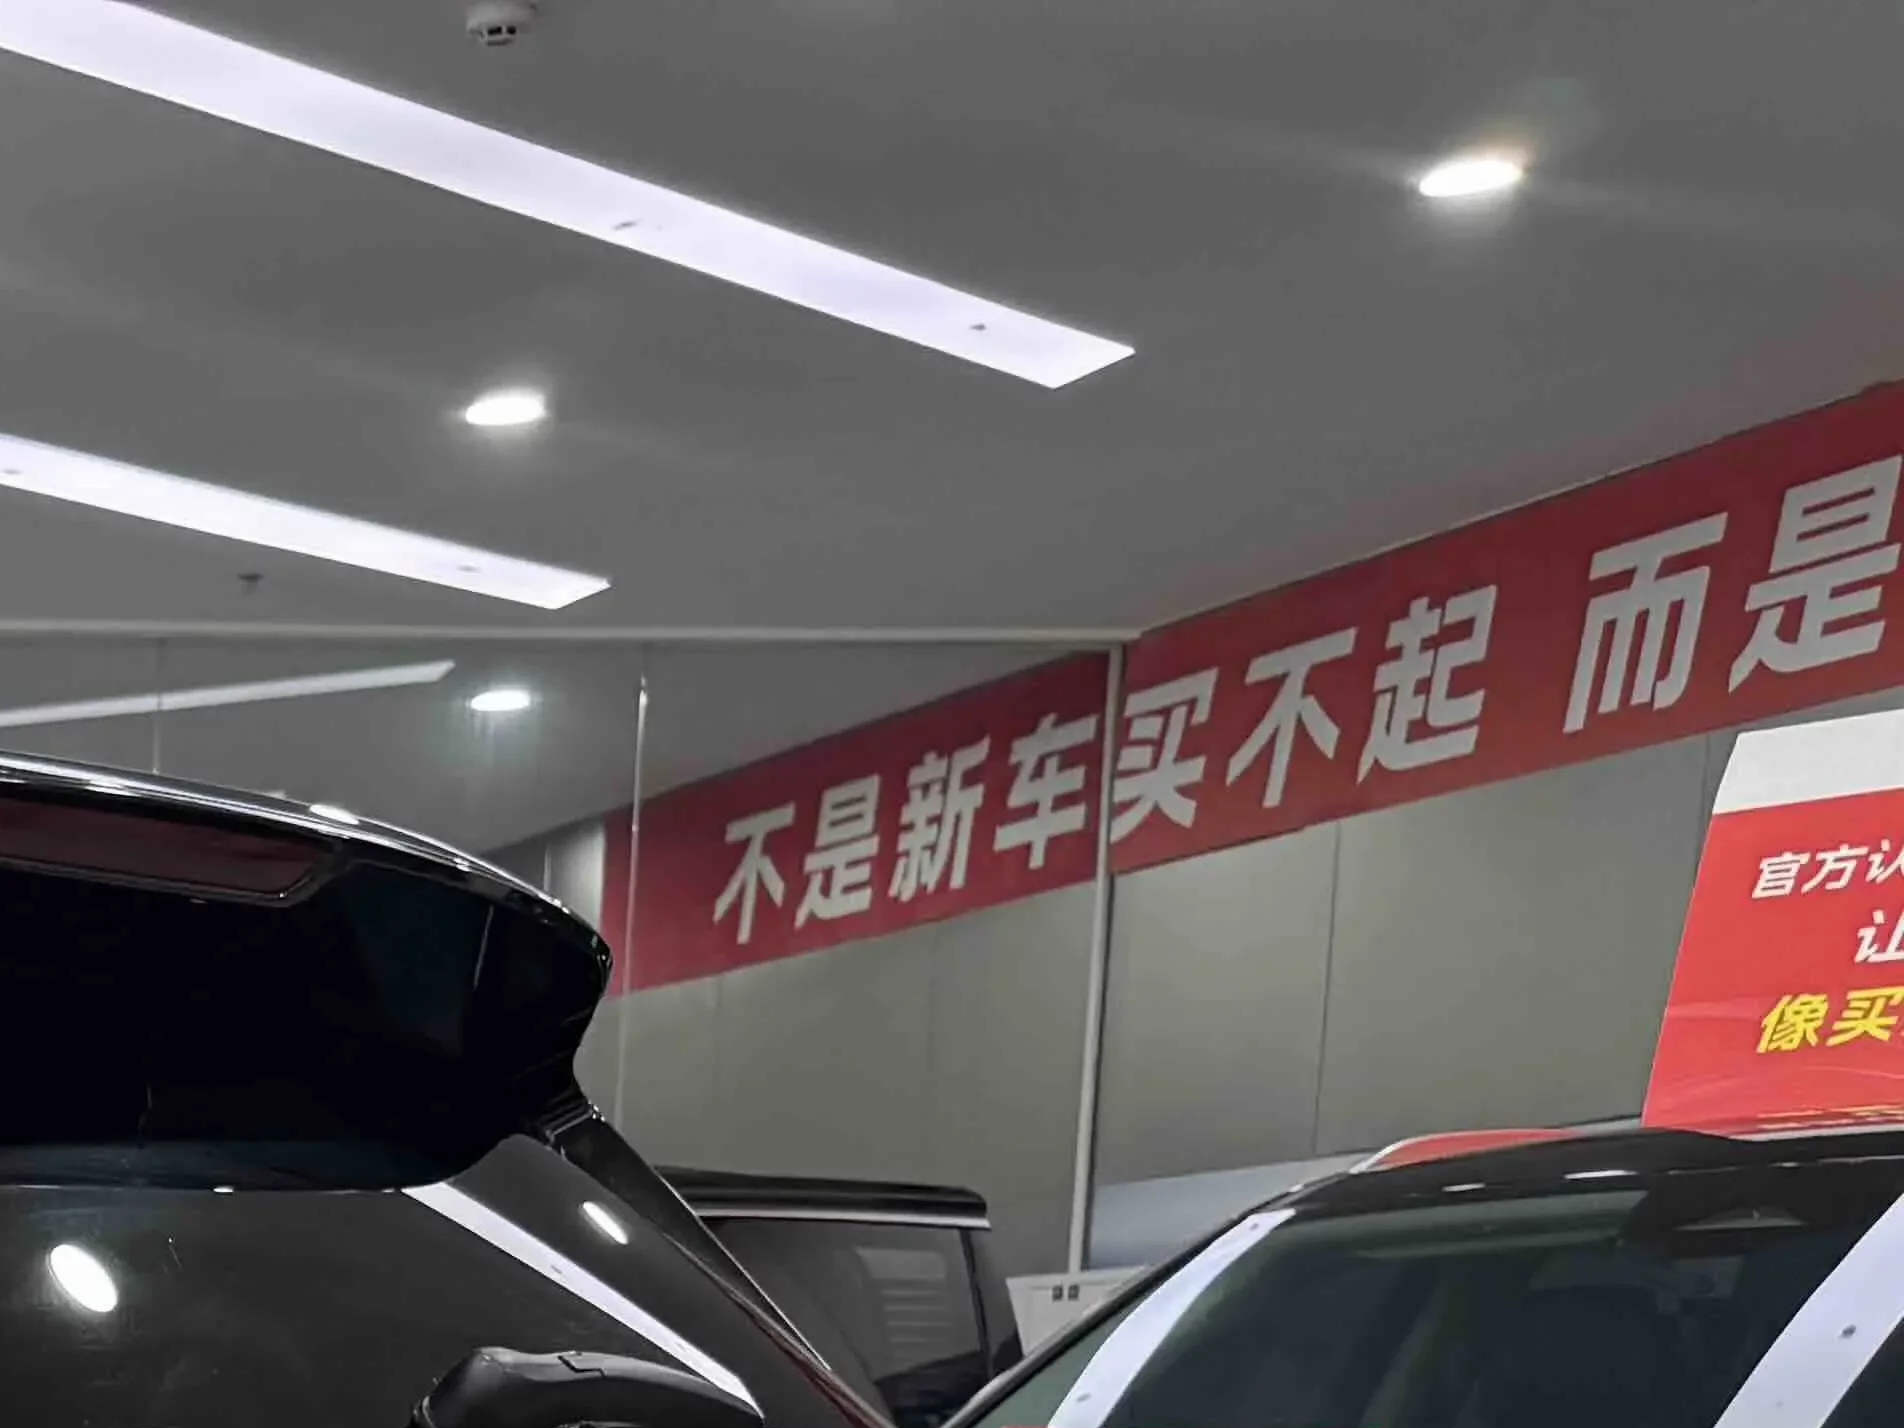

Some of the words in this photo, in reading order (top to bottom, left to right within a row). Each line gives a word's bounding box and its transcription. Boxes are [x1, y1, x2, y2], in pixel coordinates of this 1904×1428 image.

[712, 585, 1496, 945] 不是新车买不起
[1563, 454, 1904, 734] 而是
[1756, 985, 1904, 1053] 像买
